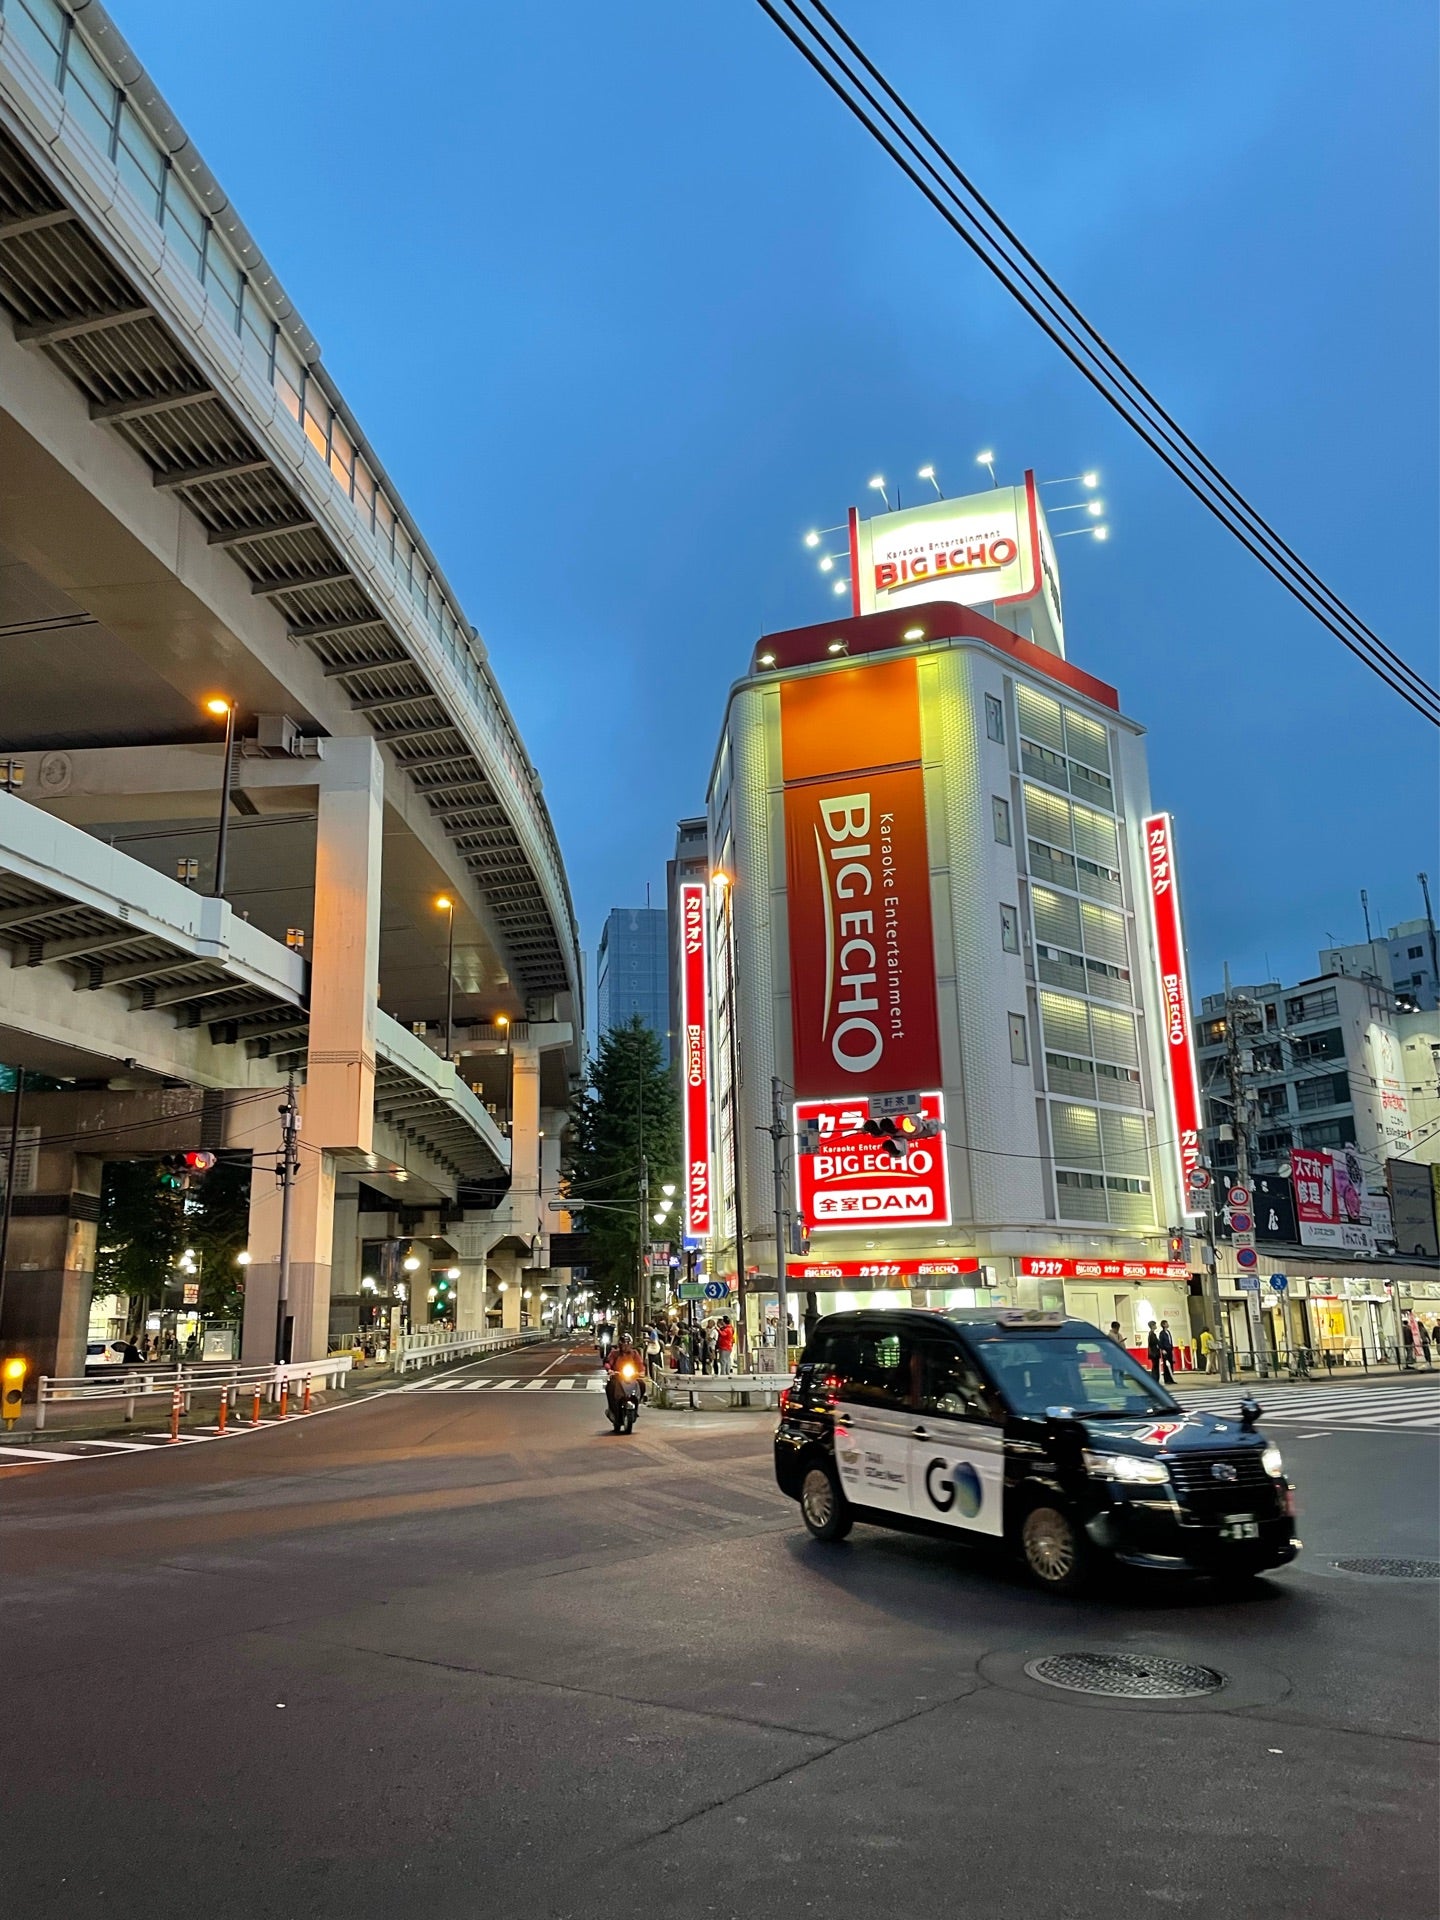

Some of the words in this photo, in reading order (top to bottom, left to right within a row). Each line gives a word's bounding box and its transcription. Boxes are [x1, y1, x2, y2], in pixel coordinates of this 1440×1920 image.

[887, 546, 924, 560] Karaoke
[929, 530, 1000, 551] Entertainment
[874, 556, 929, 591] BIG
[934, 537, 1018, 571] ECHO
[819, 792, 873, 900] BIG
[879, 812, 895, 888] Karaoke
[1149, 828, 1171, 896] カラオケ
[685, 896, 702, 955] カラオケ
[884, 896, 905, 1040] Entertainment
[831, 909, 884, 1073] ECHO
[1163, 974, 1179, 1002] BIG
[687, 1024, 701, 1050] BIG
[1169, 1003, 1184, 1046] ECHO
[689, 1050, 702, 1087] ECHO
[812, 1155, 860, 1180] BIG
[863, 1150, 933, 1174] ECHO
[823, 1144, 856, 1153] Karaoke
[1293, 1155, 1323, 1179] スマホ
[691, 1160, 708, 1225] カラオケ
[1233, 1191, 1245, 1200] 40
[1297, 1179, 1322, 1205] 修理
[859, 1265, 901, 1276] カラオケ
[1030, 1261, 1063, 1276] カラオケ
[708, 1284, 717, 1297] 3
[925, 1457, 983, 1519] GO
